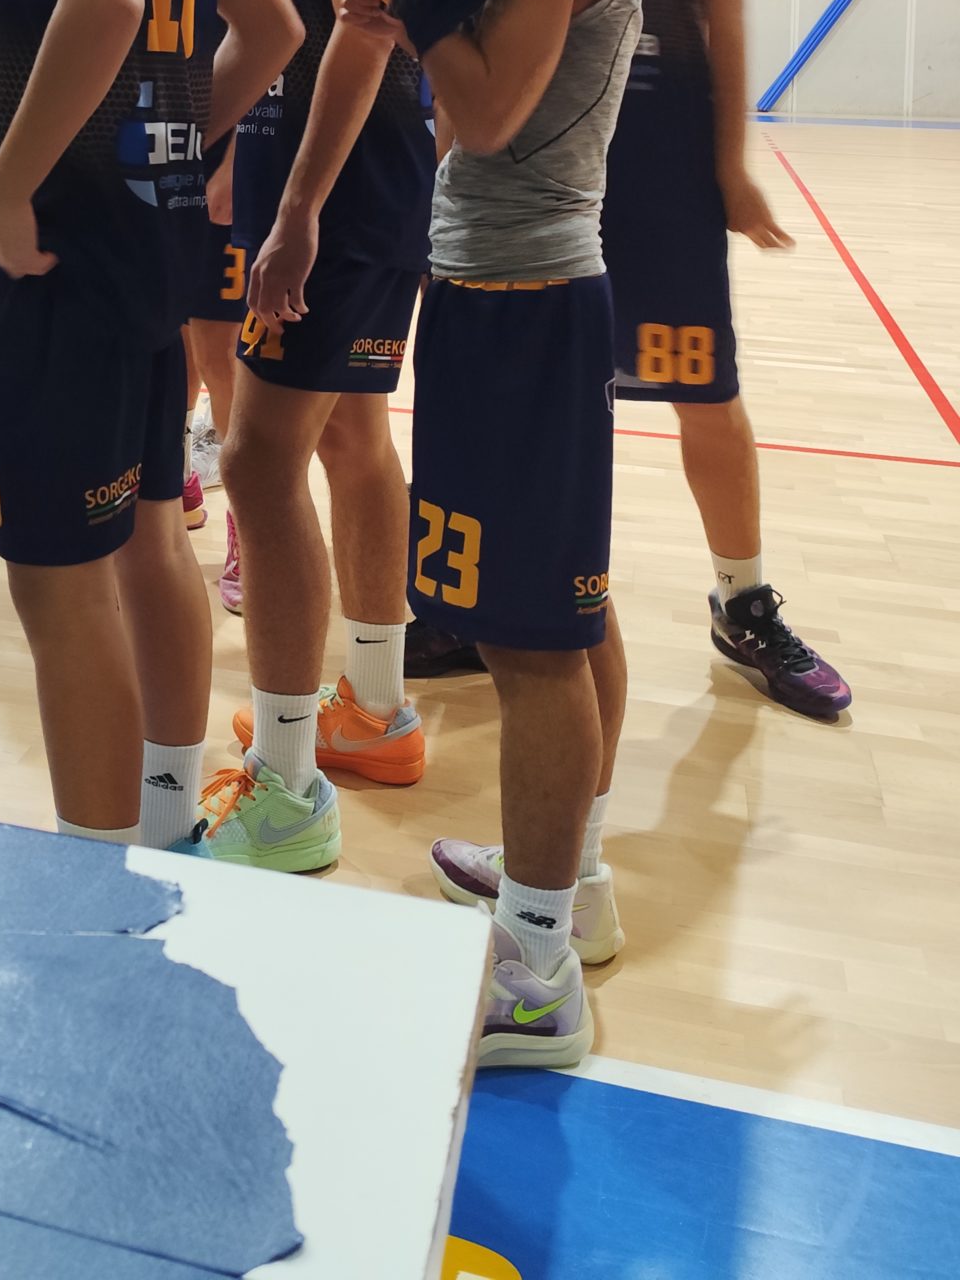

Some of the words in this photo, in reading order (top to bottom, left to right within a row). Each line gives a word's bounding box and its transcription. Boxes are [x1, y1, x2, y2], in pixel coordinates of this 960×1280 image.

[637, 322, 716, 385] 88
[414, 498, 482, 609] 23
[144, 778, 184, 792] adidas
